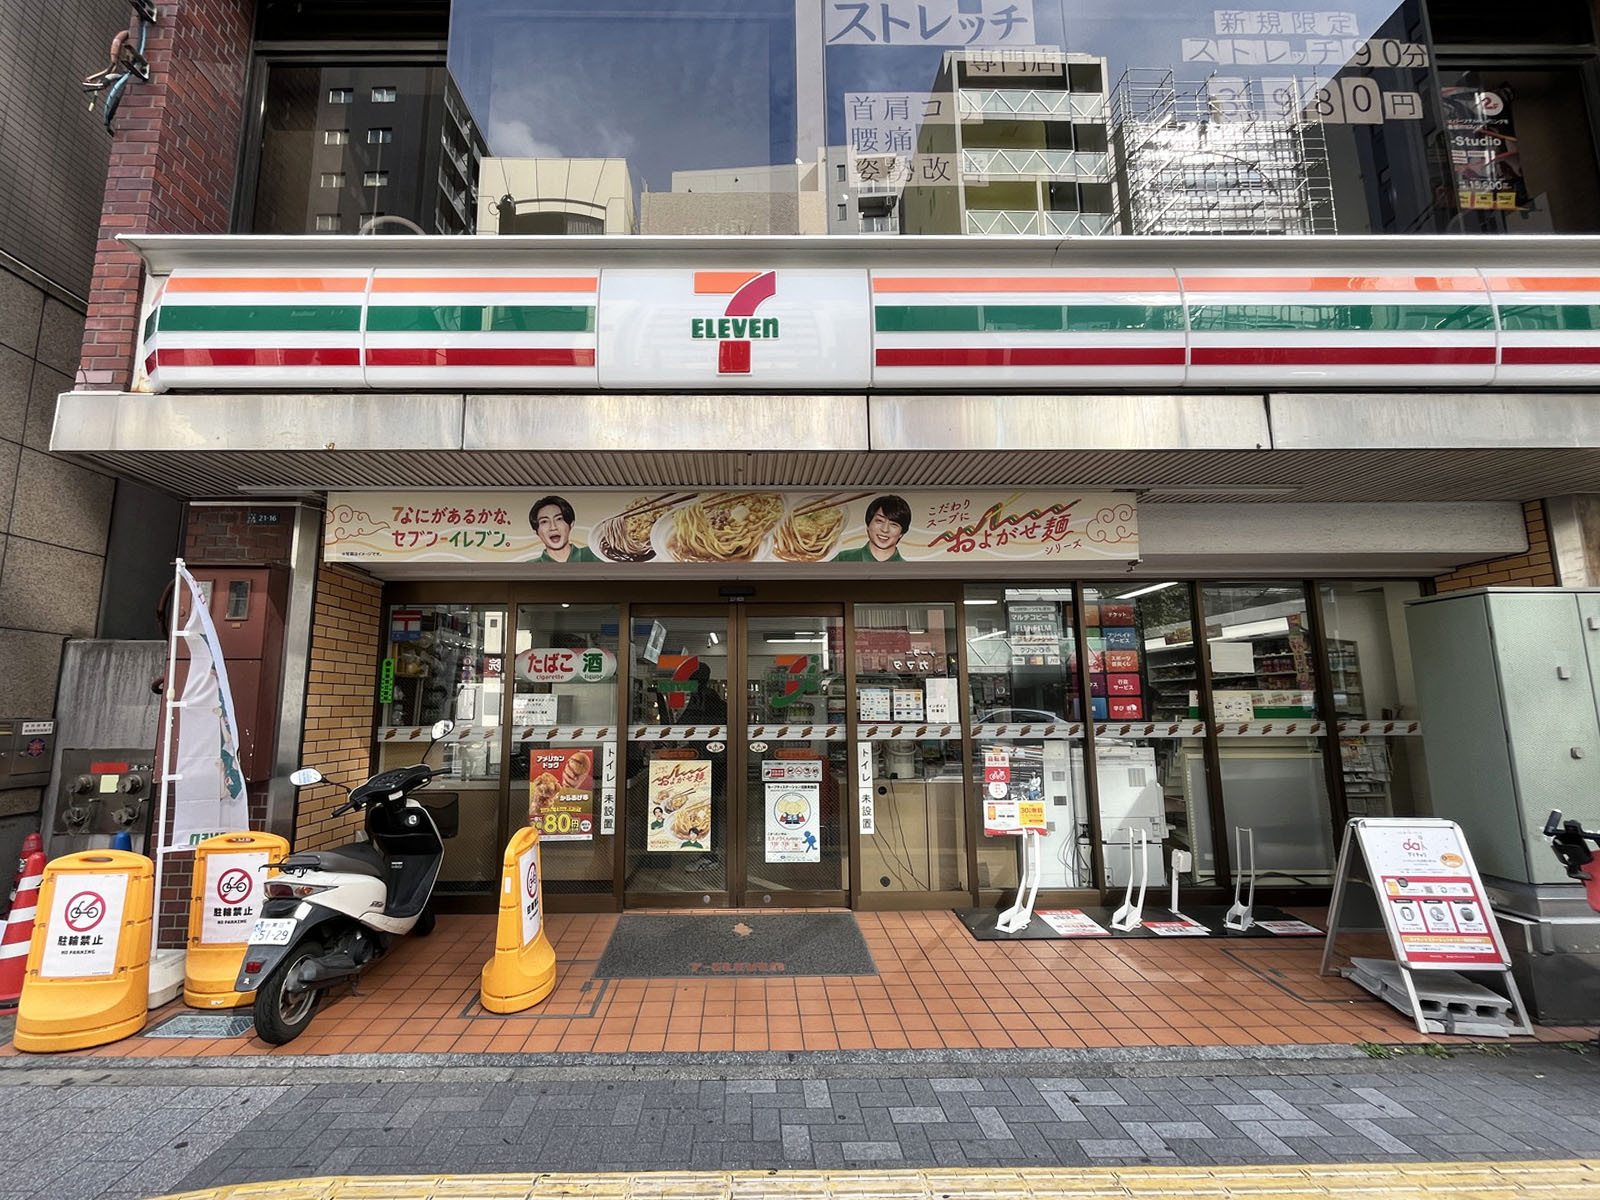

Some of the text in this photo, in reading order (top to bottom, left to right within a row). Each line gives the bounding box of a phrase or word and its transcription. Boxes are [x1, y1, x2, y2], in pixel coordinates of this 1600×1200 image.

[828, 3, 1028, 45] ストレッチ
[1220, 11, 1350, 34] 新規限定
[850, 127, 912, 151] 腰痛
[929, 499, 971, 516] こだわり
[927, 513, 971, 528] スープに
[1045, 541, 1082, 556] シリーズ
[528, 653, 603, 673] たばこ 酒
[213, 906, 253, 917] 駐輪禁止
[57, 935, 104, 947] 駐輪禁止
